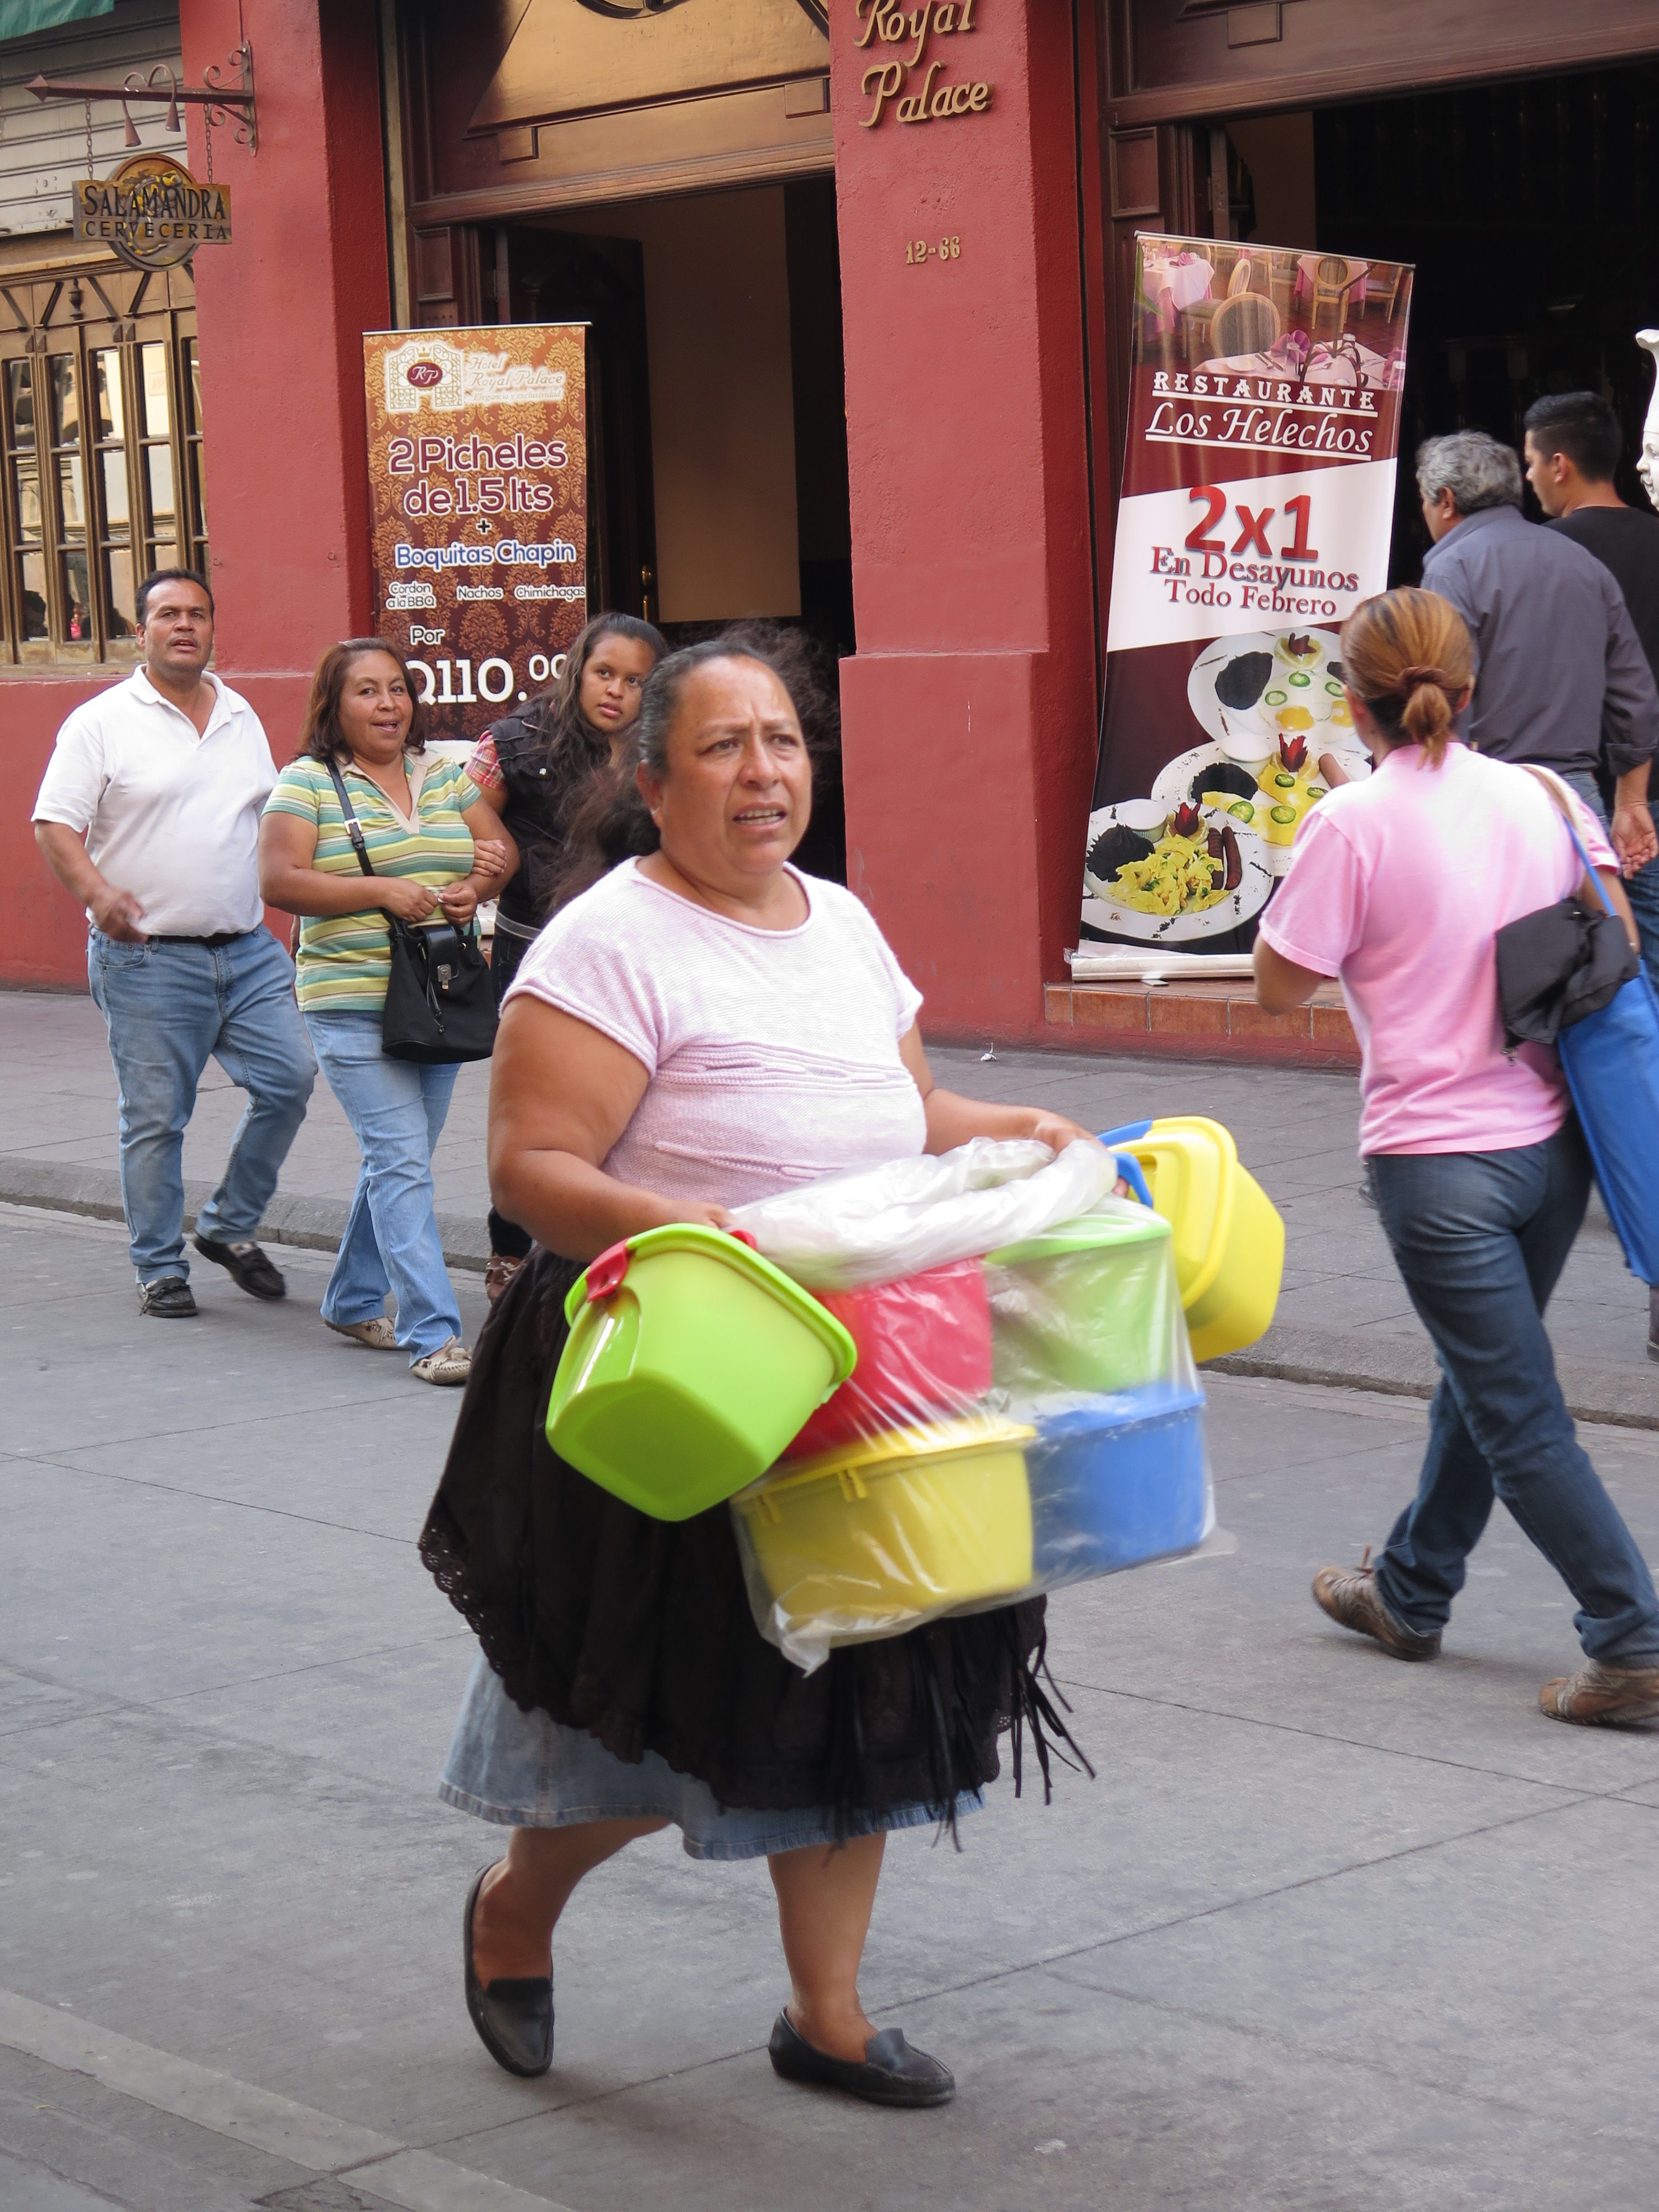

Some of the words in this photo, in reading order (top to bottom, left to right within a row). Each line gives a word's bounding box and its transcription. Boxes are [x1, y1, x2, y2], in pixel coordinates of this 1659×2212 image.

[853, 0, 974, 67] Royal
[858, 61, 993, 127] Palace
[85, 186, 226, 219] SALAMANDRA
[86, 221, 228, 239] CERVECERIA
[905, 236, 960, 264] 12-66
[469, 356, 504, 369] Hotel
[469, 371, 512, 392] Royal
[514, 369, 563, 385] Palace
[1153, 371, 1375, 411] RESTAURANTE
[1145, 402, 1212, 439] Los
[1217, 408, 1374, 453] Helechos
[389, 437, 414, 474] 2
[419, 434, 567, 473] Picheles
[404, 481, 451, 515] de
[1185, 484, 1319, 561] 2x1
[396, 542, 494, 571] Boquitas
[495, 539, 576, 568] Chapin
[1150, 546, 1192, 577] En
[1201, 550, 1360, 591] Desayunos
[388, 599, 395, 608] a
[397, 598, 406, 607] la
[408, 596, 435, 607] BBQ
[390, 582, 431, 594] Cordon
[458, 586, 502, 599] Nachos
[516, 585, 586, 601] Chimichagas
[1165, 578, 1232, 607] Todo
[1240, 585, 1337, 617] Febrero
[410, 626, 444, 645] Por
